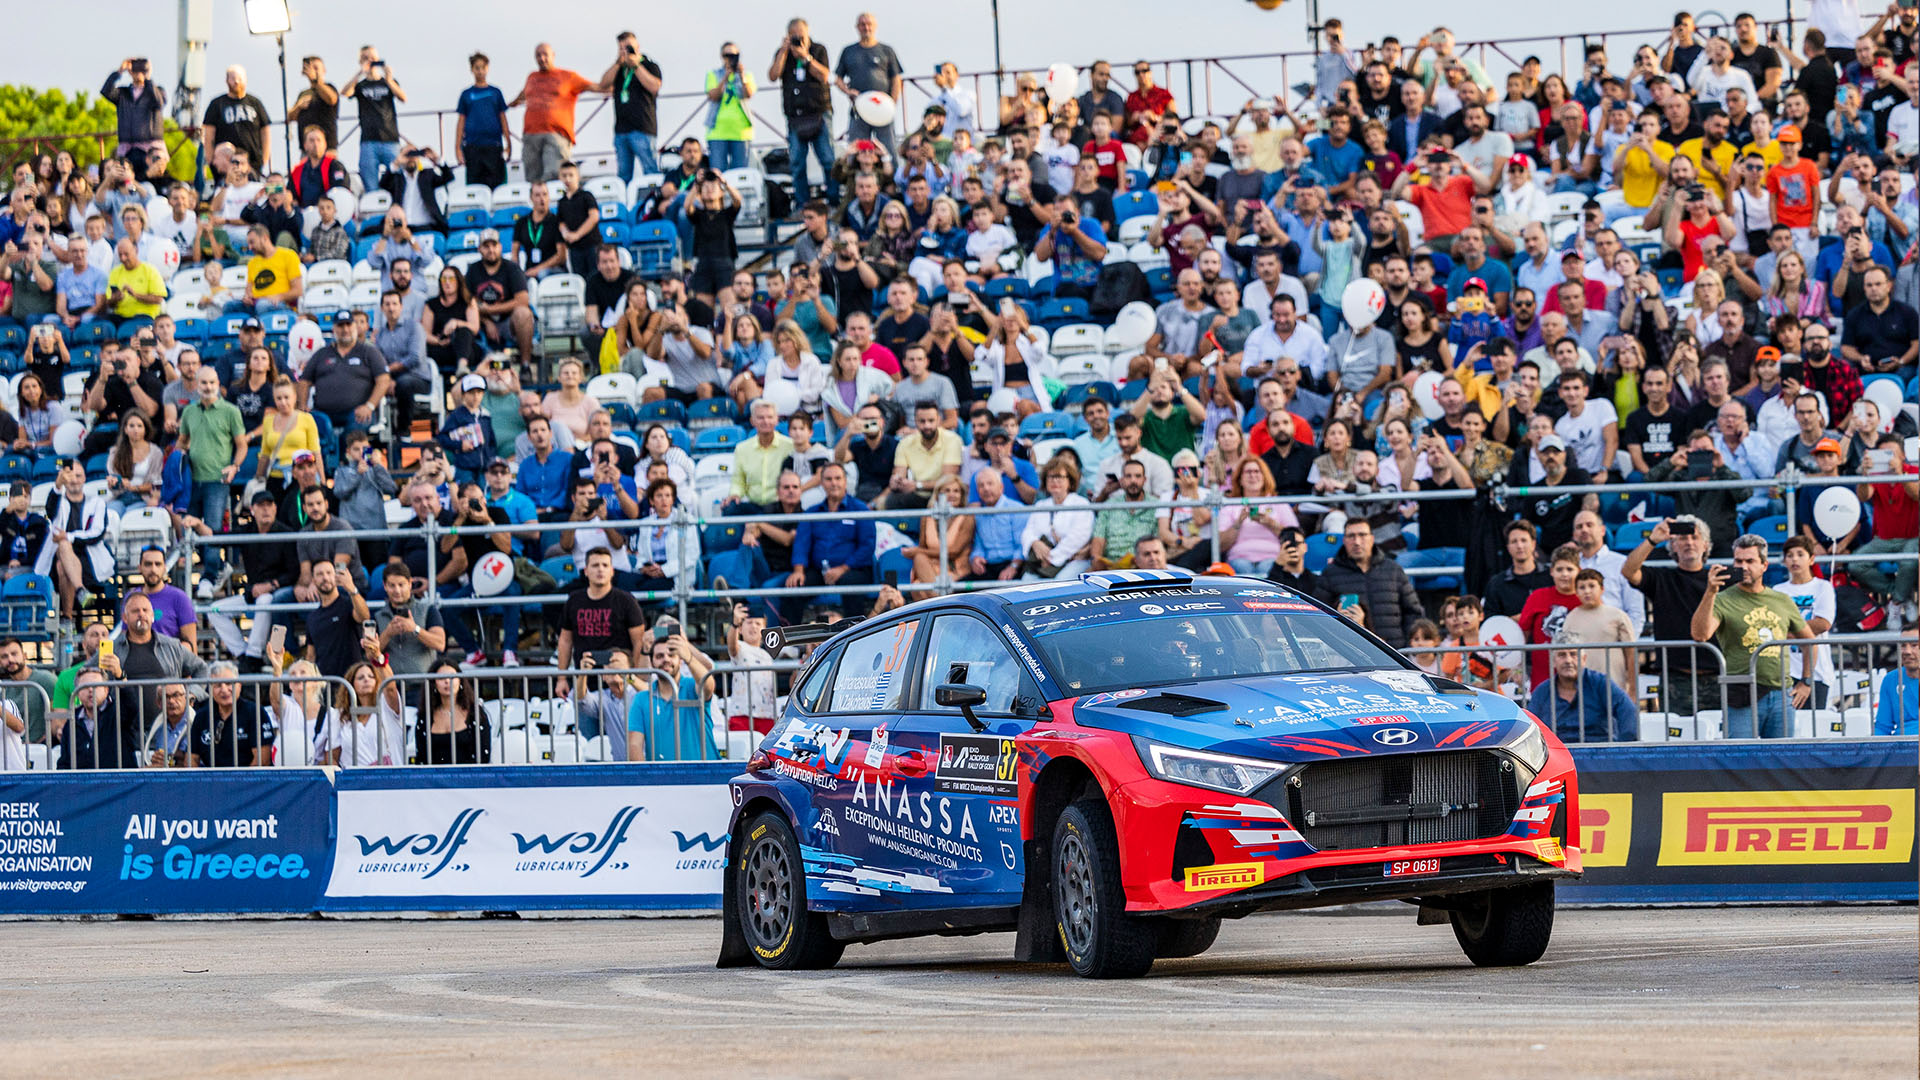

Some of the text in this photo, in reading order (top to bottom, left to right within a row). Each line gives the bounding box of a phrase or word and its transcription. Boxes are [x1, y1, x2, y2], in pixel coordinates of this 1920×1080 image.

[1060, 588, 1222, 609] HYUNDAI HELLAS
[1165, 602, 1225, 611] WRC
[885, 621, 920, 673] 37
[998, 740, 1019, 781] 37
[783, 763, 839, 792] HYUNDAI HELLAS
[0, 802, 40, 819] REEK
[989, 806, 1018, 825] APEX
[0, 820, 64, 837] ATIONAL
[124, 814, 278, 846] All you want
[813, 821, 841, 836] AXIA
[844, 805, 983, 863] EXCEPTIONAL HELLENIC PRODUCTS
[1683, 804, 1893, 853] PIRELLI
[0, 838, 57, 855] OURISM
[353, 807, 486, 880] wolf
[511, 805, 646, 878] wolf
[867, 832, 958, 870] WWW.ANASSAORGANICS.COM
[120, 843, 311, 881] is Greece.
[358, 862, 431, 873] LUBRICANTS
[515, 860, 589, 872] LUBRICANTS
[1393, 861, 1411, 874] SP
[1412, 859, 1438, 873] 0613
[1191, 867, 1258, 887] PIRELLI
